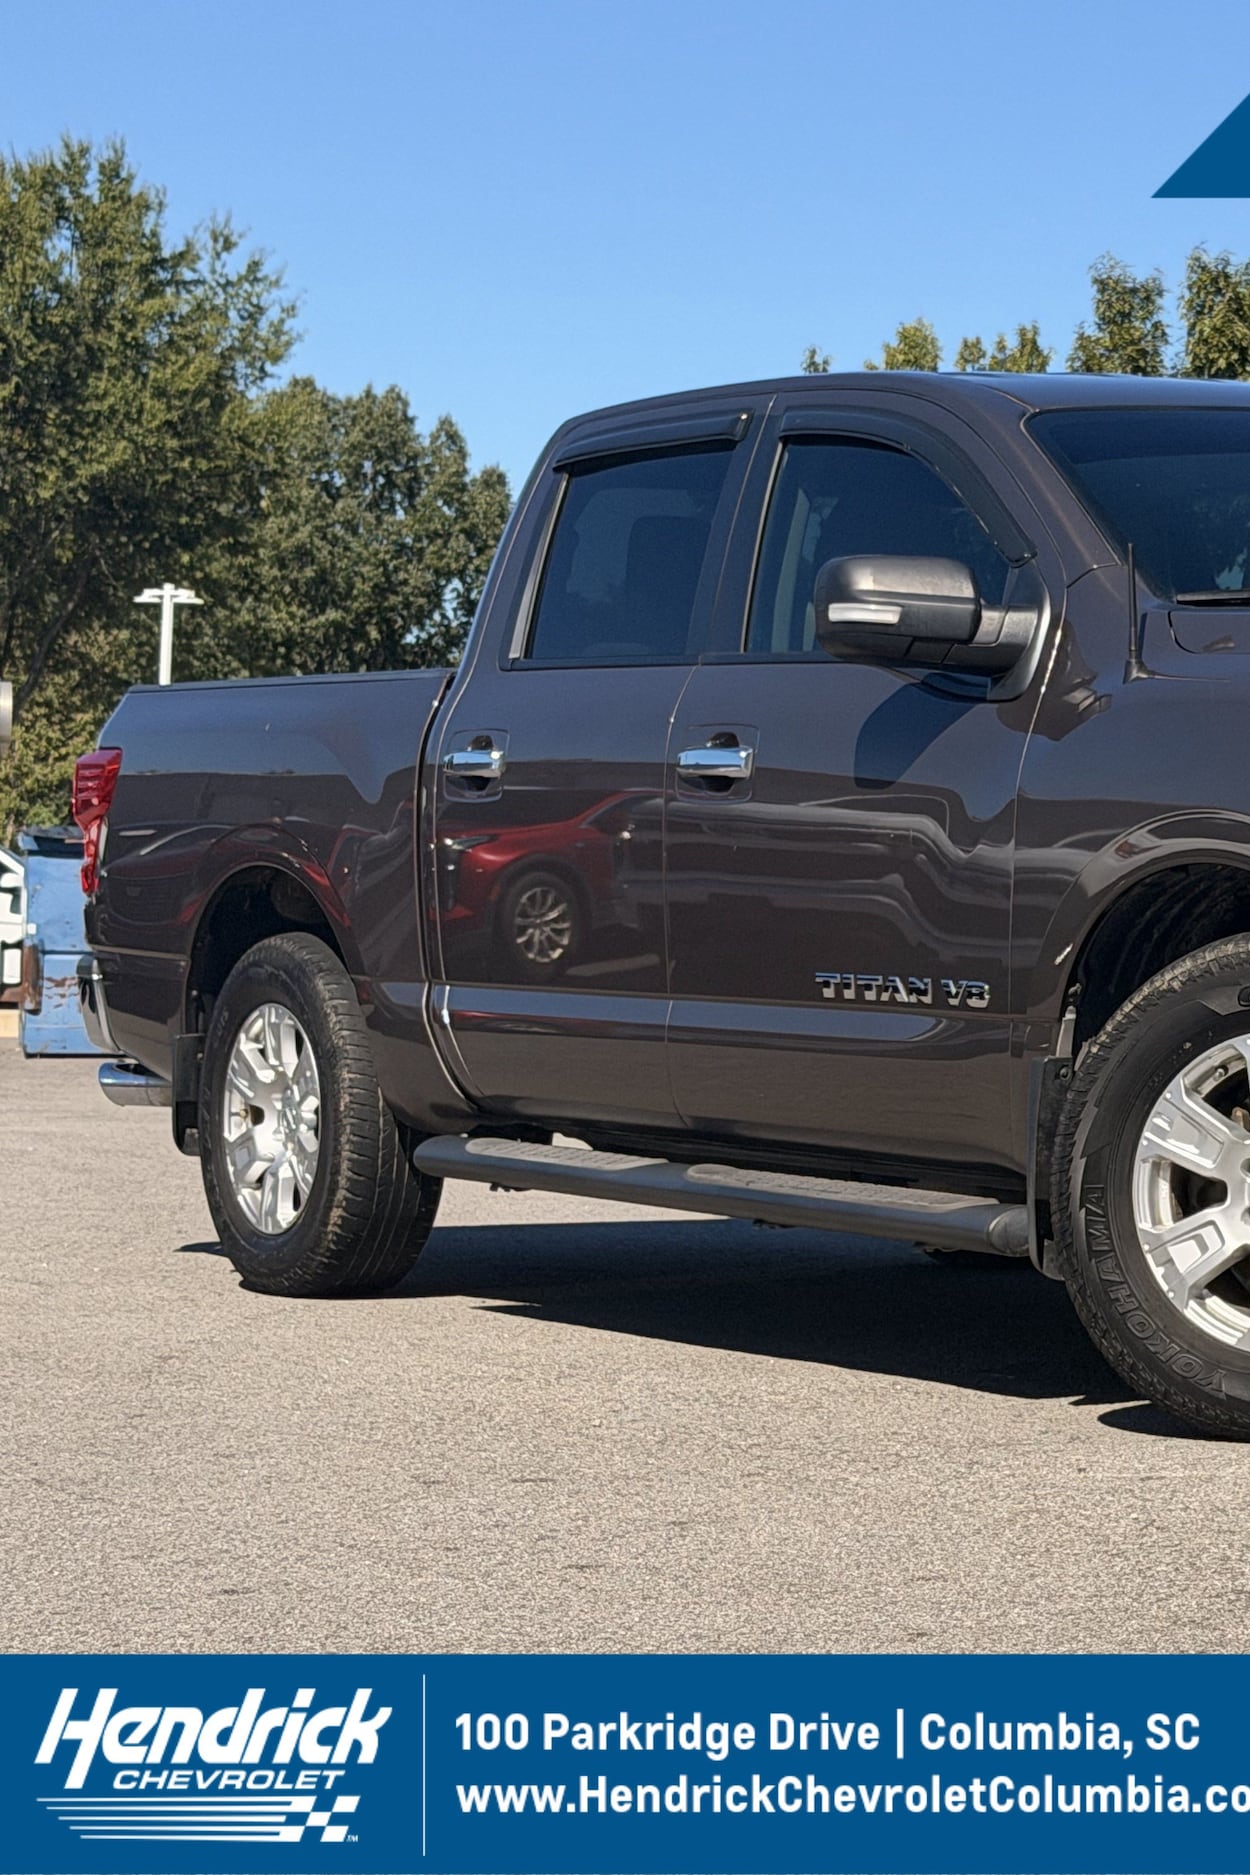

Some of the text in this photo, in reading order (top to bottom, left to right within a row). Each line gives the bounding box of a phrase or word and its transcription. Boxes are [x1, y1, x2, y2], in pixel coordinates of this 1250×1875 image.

[814, 972, 991, 1009] TITAN V8
[1084, 1184, 1226, 1400] YOKOHAMA
